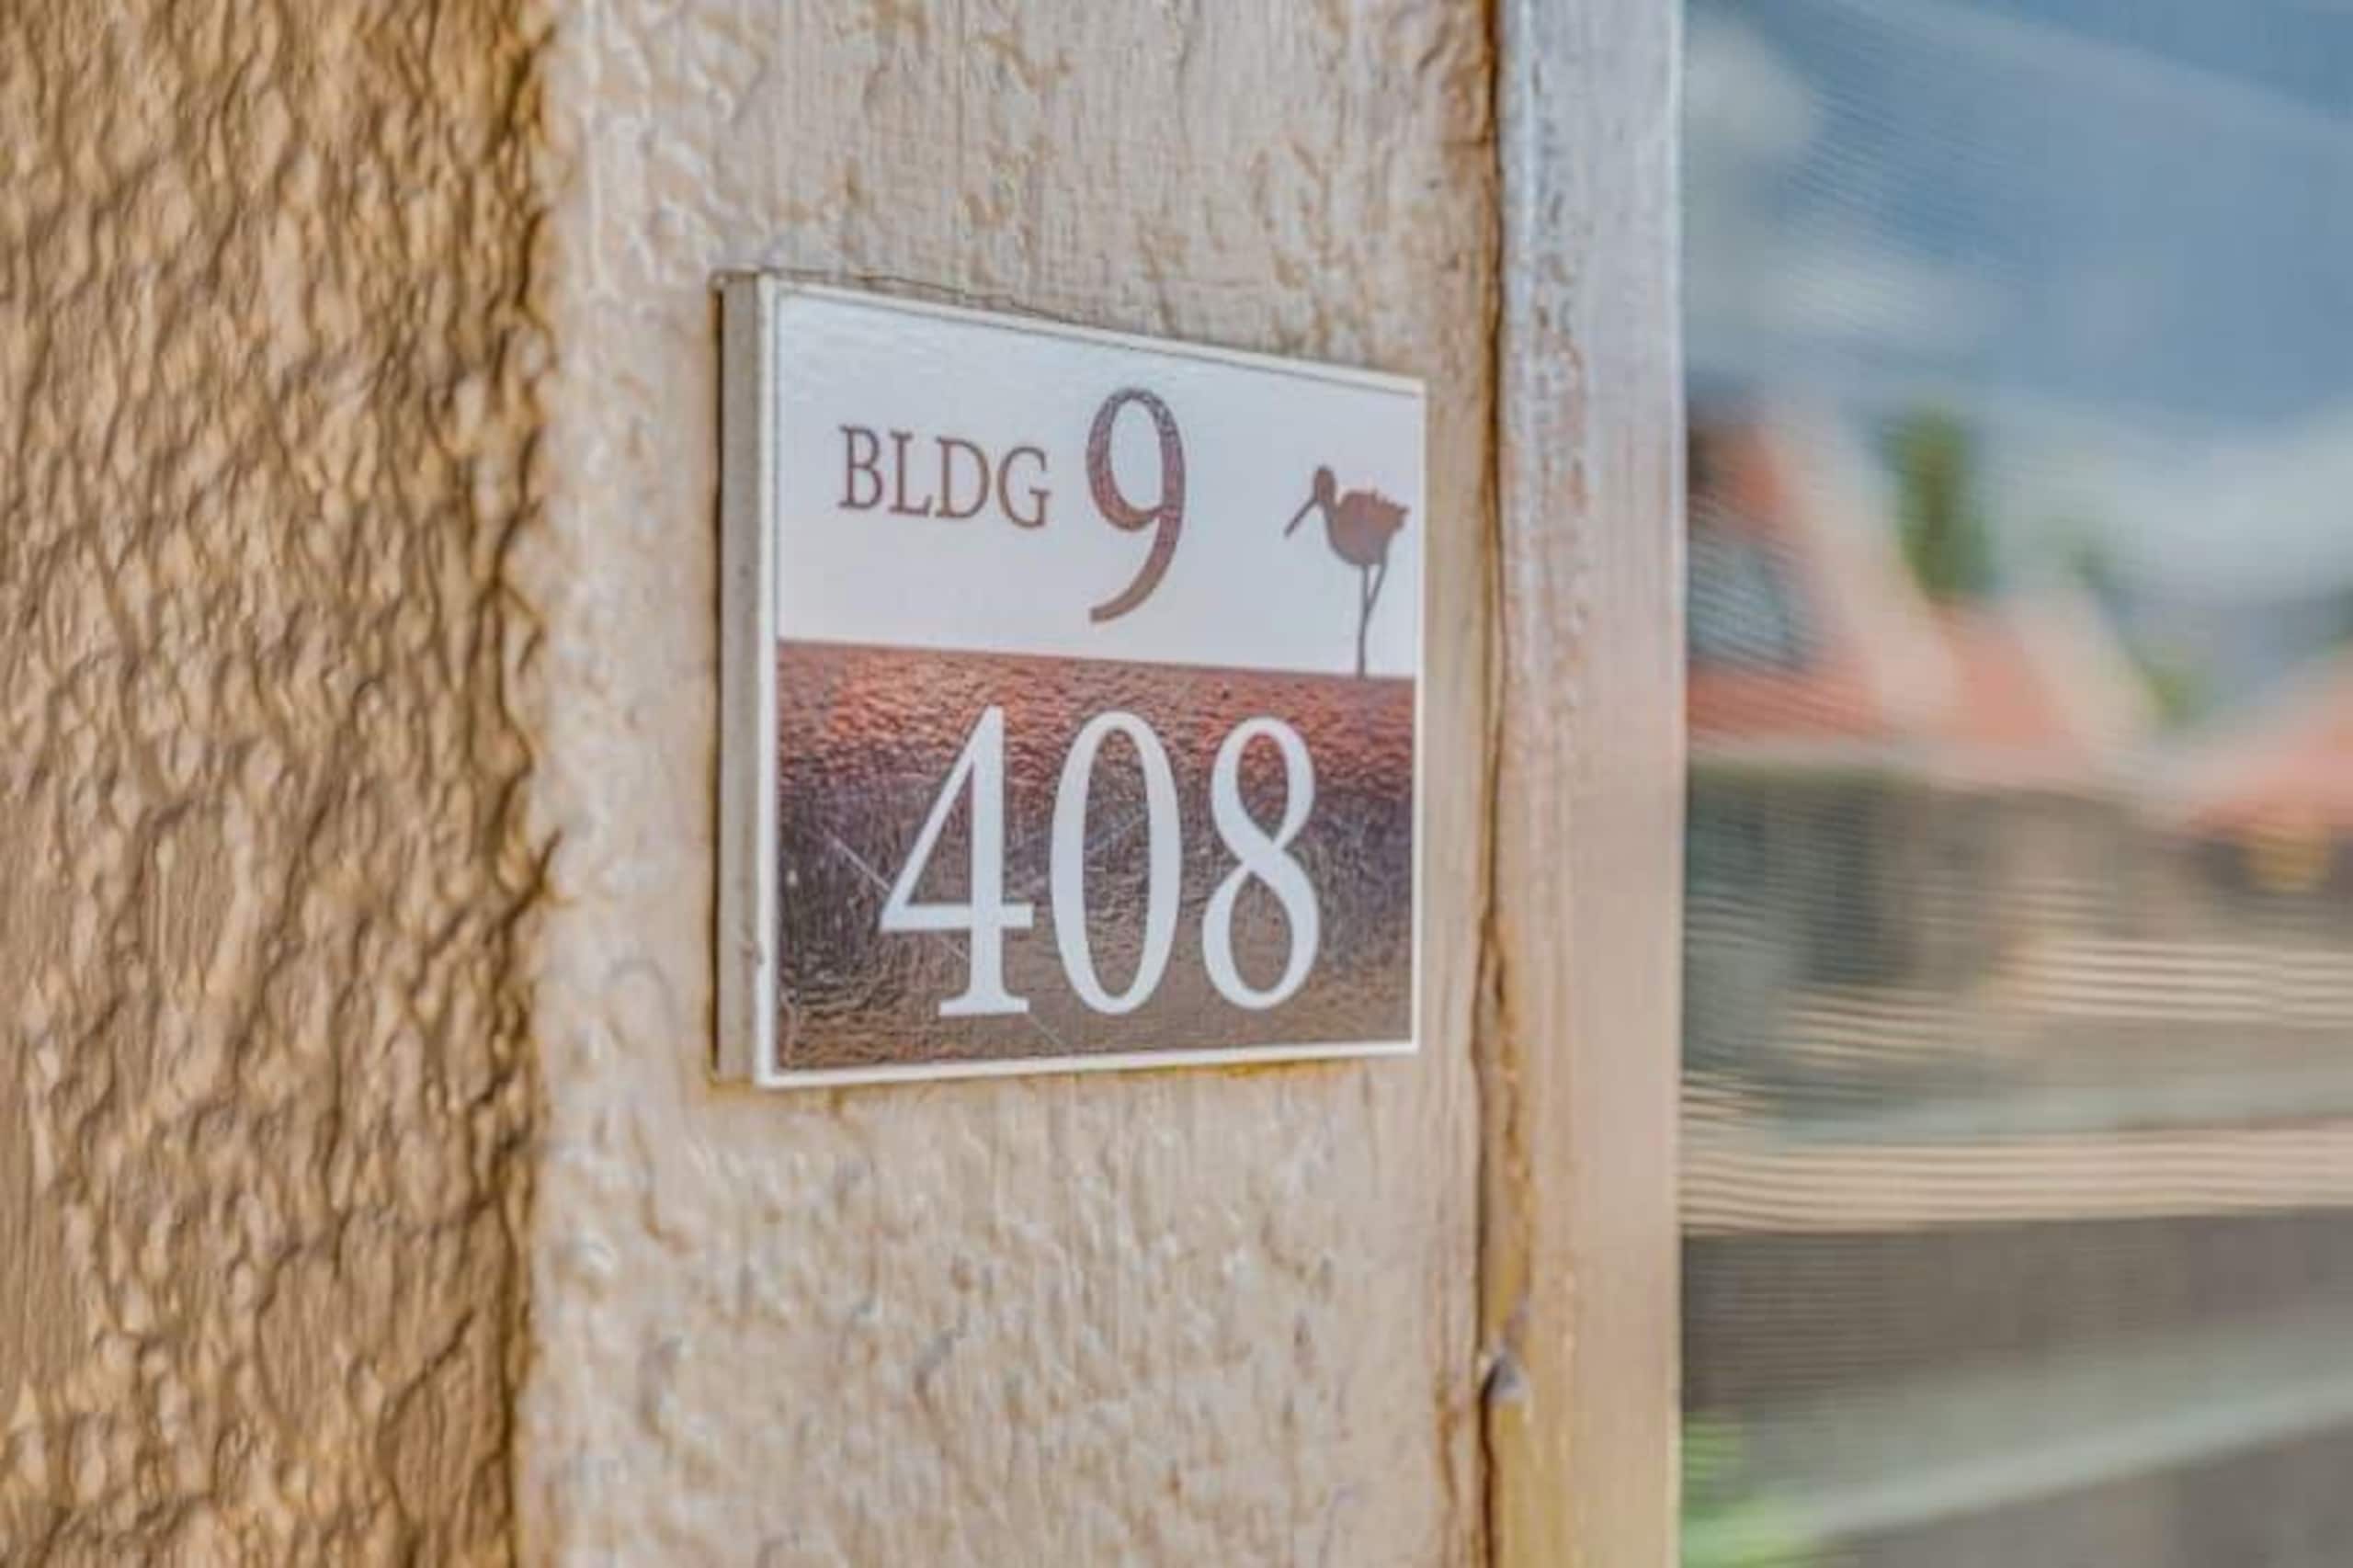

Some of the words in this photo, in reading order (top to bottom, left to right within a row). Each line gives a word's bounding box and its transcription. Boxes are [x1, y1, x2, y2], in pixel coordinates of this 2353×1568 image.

[837, 424, 1051, 529] BLDG
[1086, 387, 1186, 624] 9
[880, 705, 1321, 1017] 408
